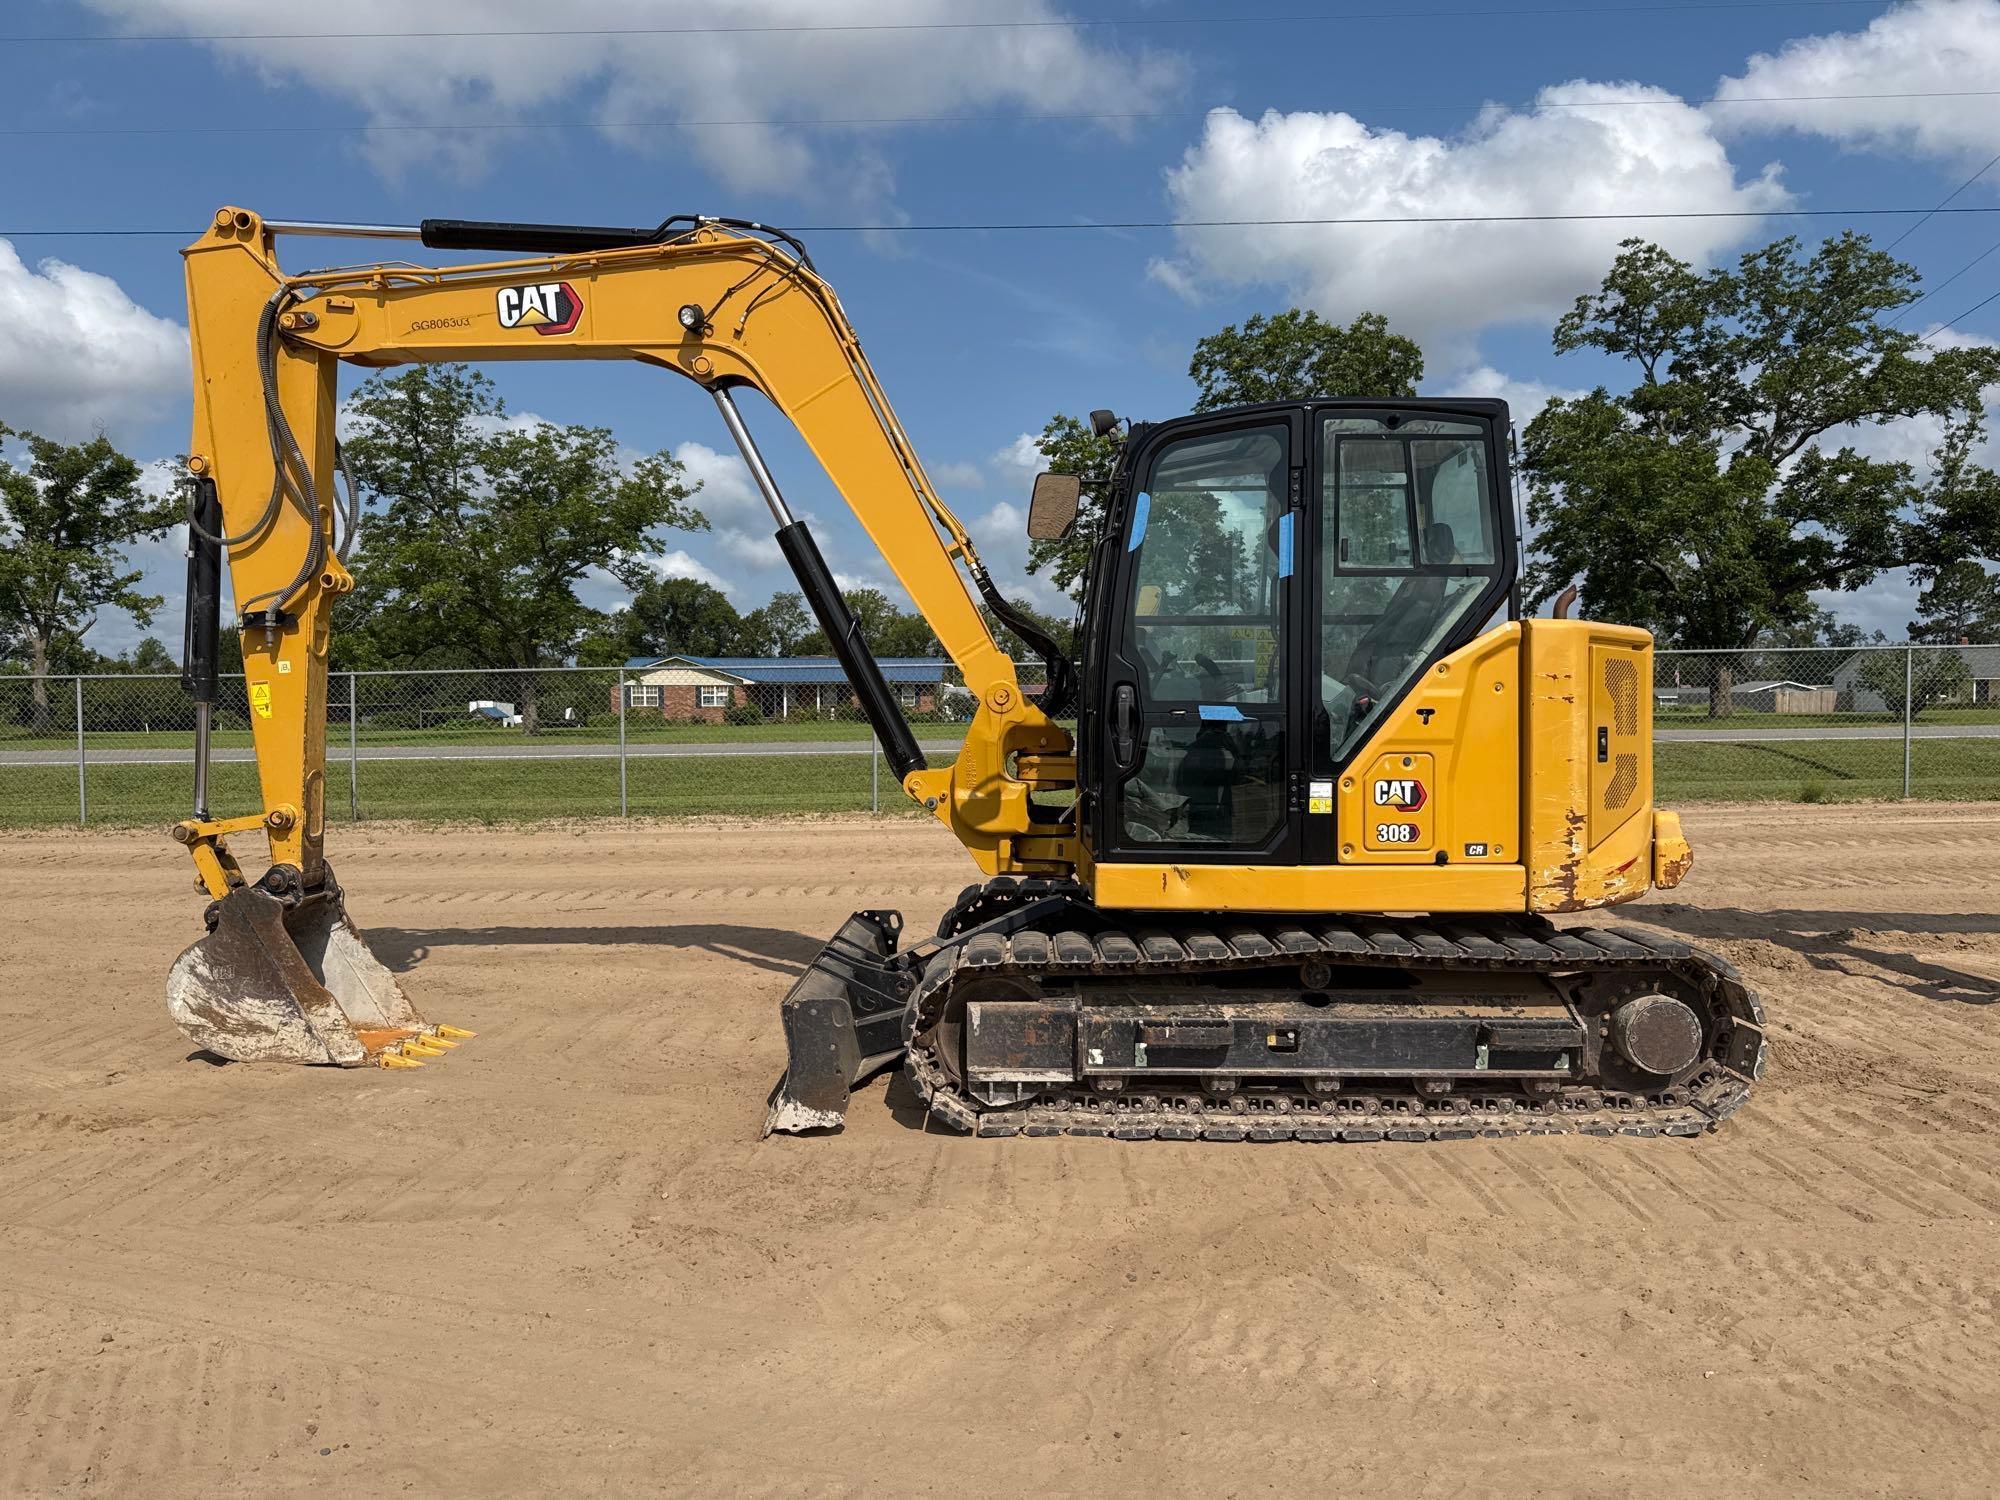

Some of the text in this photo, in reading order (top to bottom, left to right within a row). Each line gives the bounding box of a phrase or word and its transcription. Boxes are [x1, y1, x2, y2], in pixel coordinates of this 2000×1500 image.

[499, 284, 560, 327] CAT
[1374, 780, 1415, 805] CAT
[1377, 824, 1410, 842] 308
[1469, 845, 1484, 855] CR
